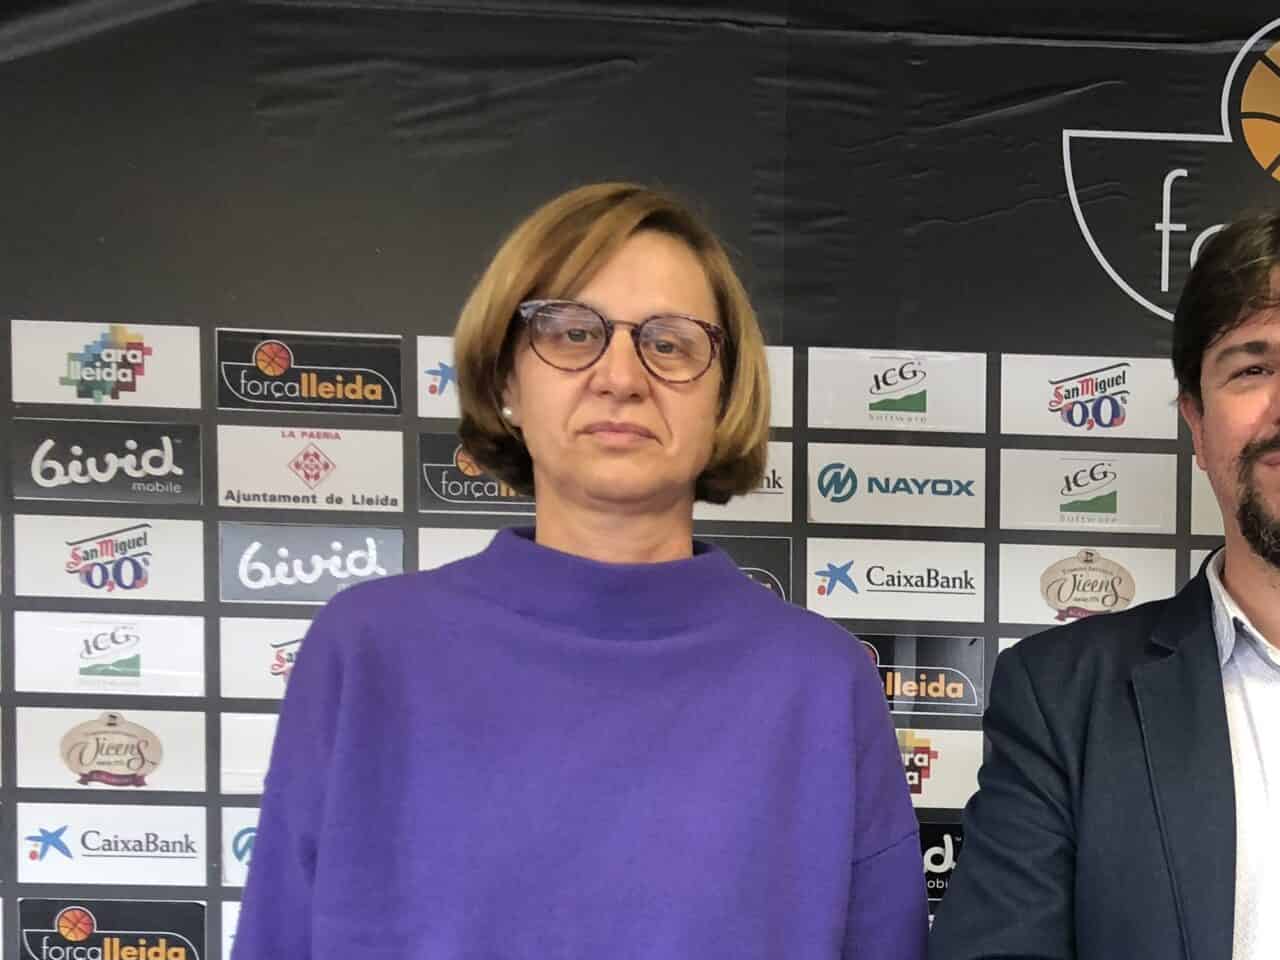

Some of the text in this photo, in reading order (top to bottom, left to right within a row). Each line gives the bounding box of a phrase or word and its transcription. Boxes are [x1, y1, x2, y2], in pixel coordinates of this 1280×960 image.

[100, 346, 142, 363] ara
[69, 361, 133, 382] lleida
[873, 360, 918, 391] ICG
[281, 430, 342, 441] LA PAERIA
[131, 481, 183, 495] mobile
[867, 476, 976, 497] NAYOX
[1062, 462, 1108, 493] ICG
[224, 489, 399, 508] Ajuntament de Lleida
[866, 565, 976, 590] CaixaBank
[81, 626, 133, 656] ICG
[80, 829, 197, 854] CaixaBank
